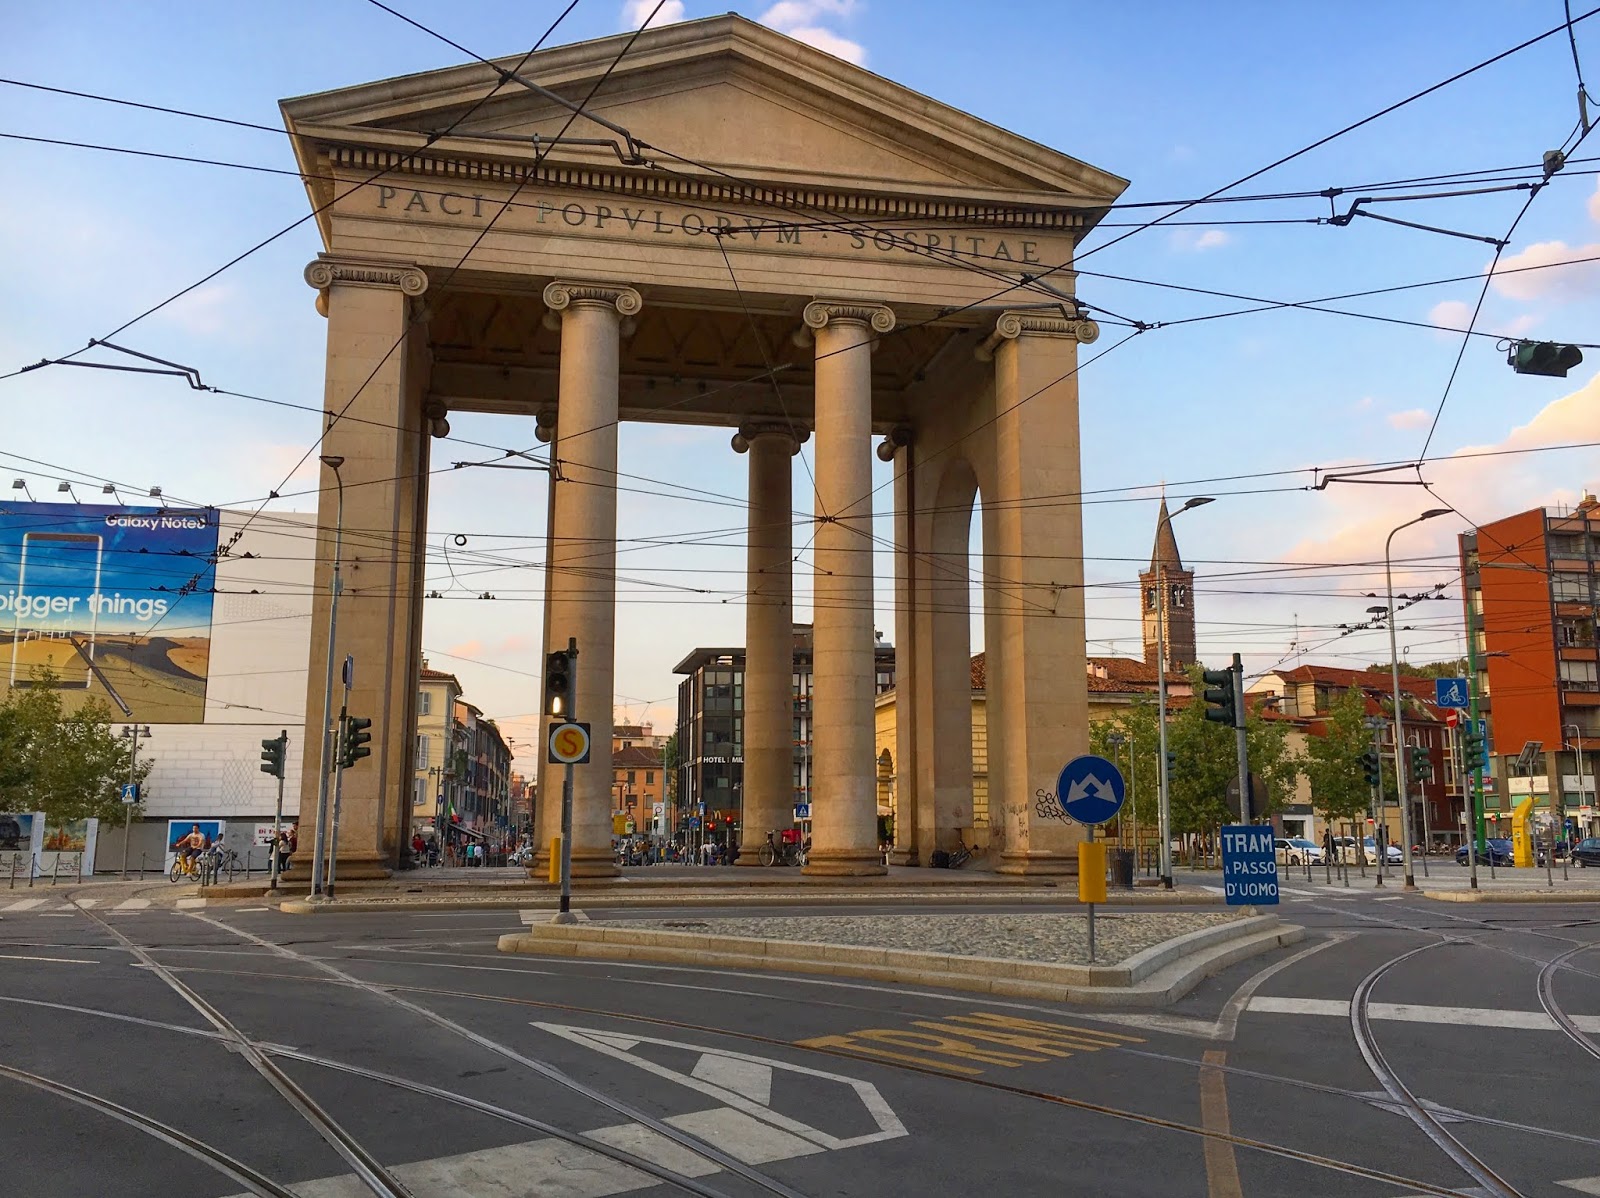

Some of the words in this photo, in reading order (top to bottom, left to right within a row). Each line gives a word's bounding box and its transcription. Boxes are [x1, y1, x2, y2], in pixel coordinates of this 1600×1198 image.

[377, 186, 483, 217] PACI
[536, 201, 802, 245] POPVLORVM
[850, 228, 1040, 263] SOSPITAE
[105, 515, 160, 531] Galaxy
[86, 592, 168, 621] things
[562, 730, 577, 756] S
[703, 756, 726, 764] HOTEL
[1223, 833, 1273, 853] TRAM
[1225, 865, 1230, 875] A
[1233, 861, 1276, 875] PASSO
[1226, 882, 1277, 897] D'UOMO
[793, 1012, 1147, 1075] TRAM
